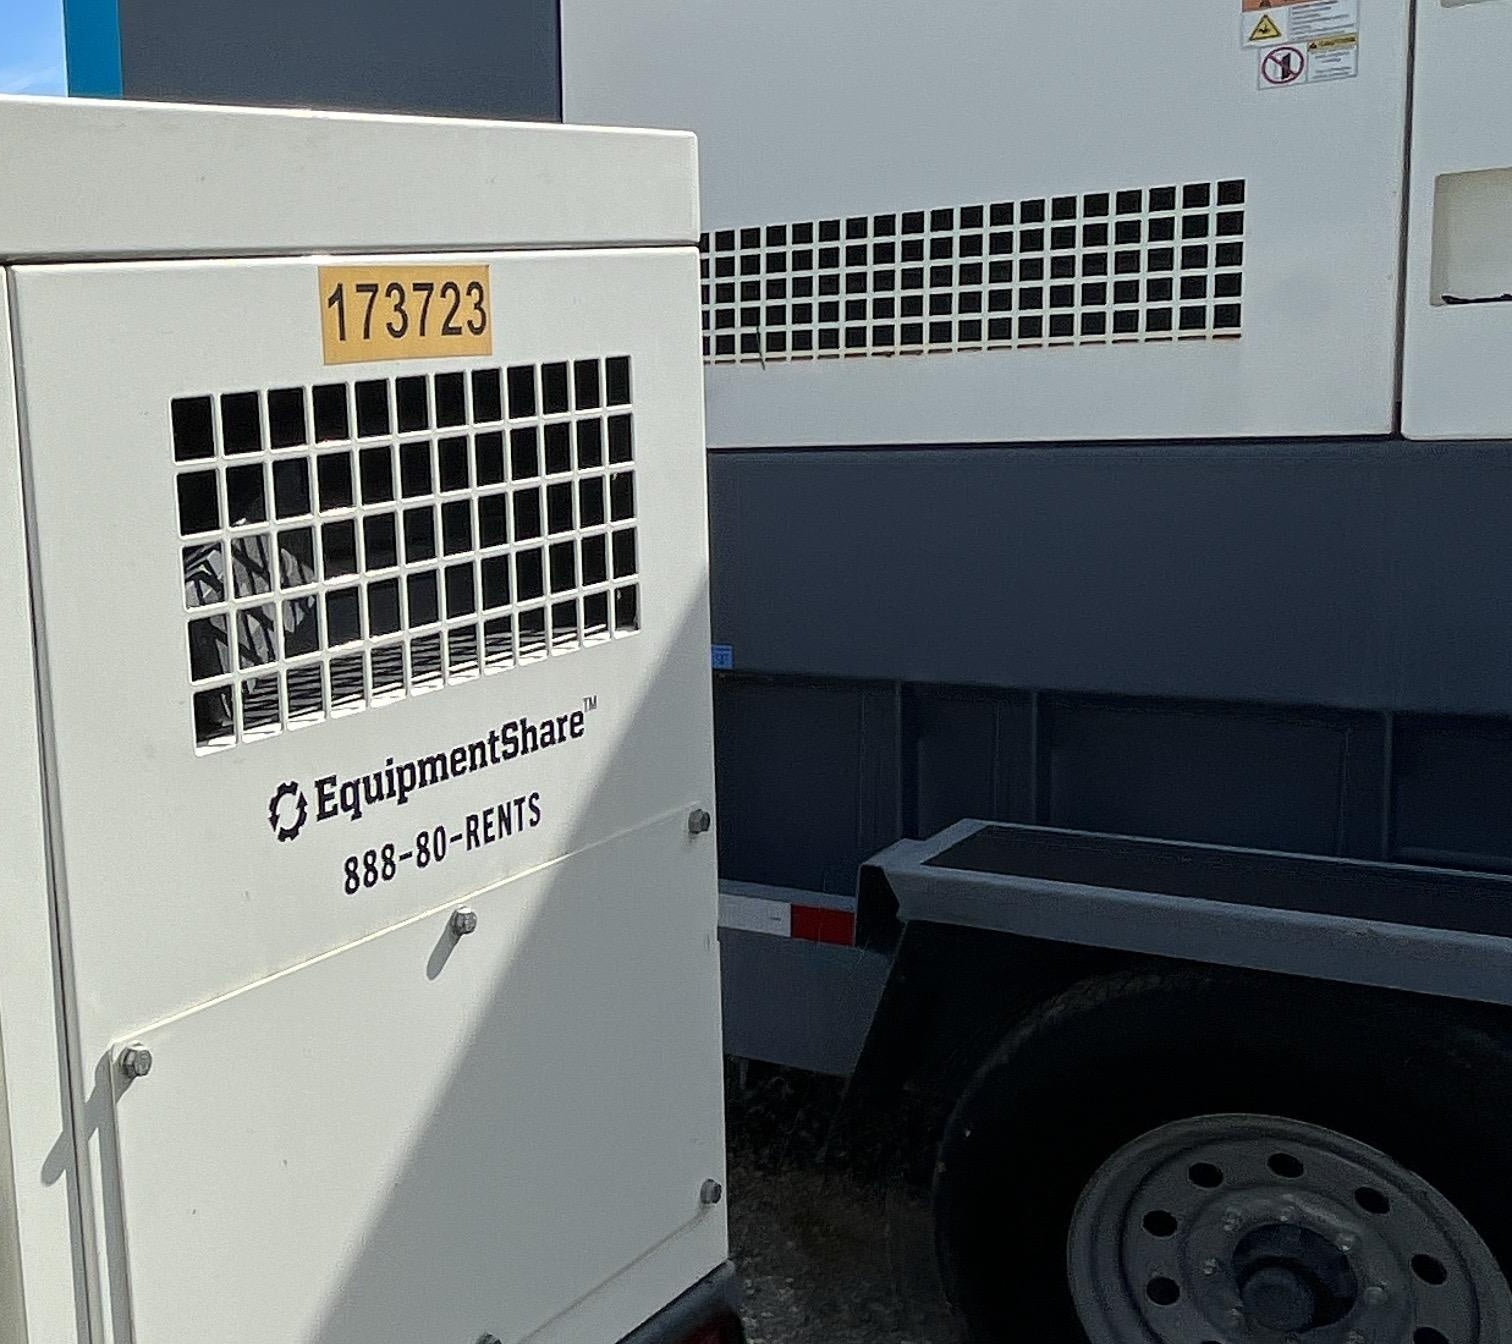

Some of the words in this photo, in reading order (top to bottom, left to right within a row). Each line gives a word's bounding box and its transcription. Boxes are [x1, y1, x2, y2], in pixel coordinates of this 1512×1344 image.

[327, 280, 488, 343] 173723
[314, 709, 585, 822] EquipmentShare
[343, 791, 542, 895] 888-80-RENTS
